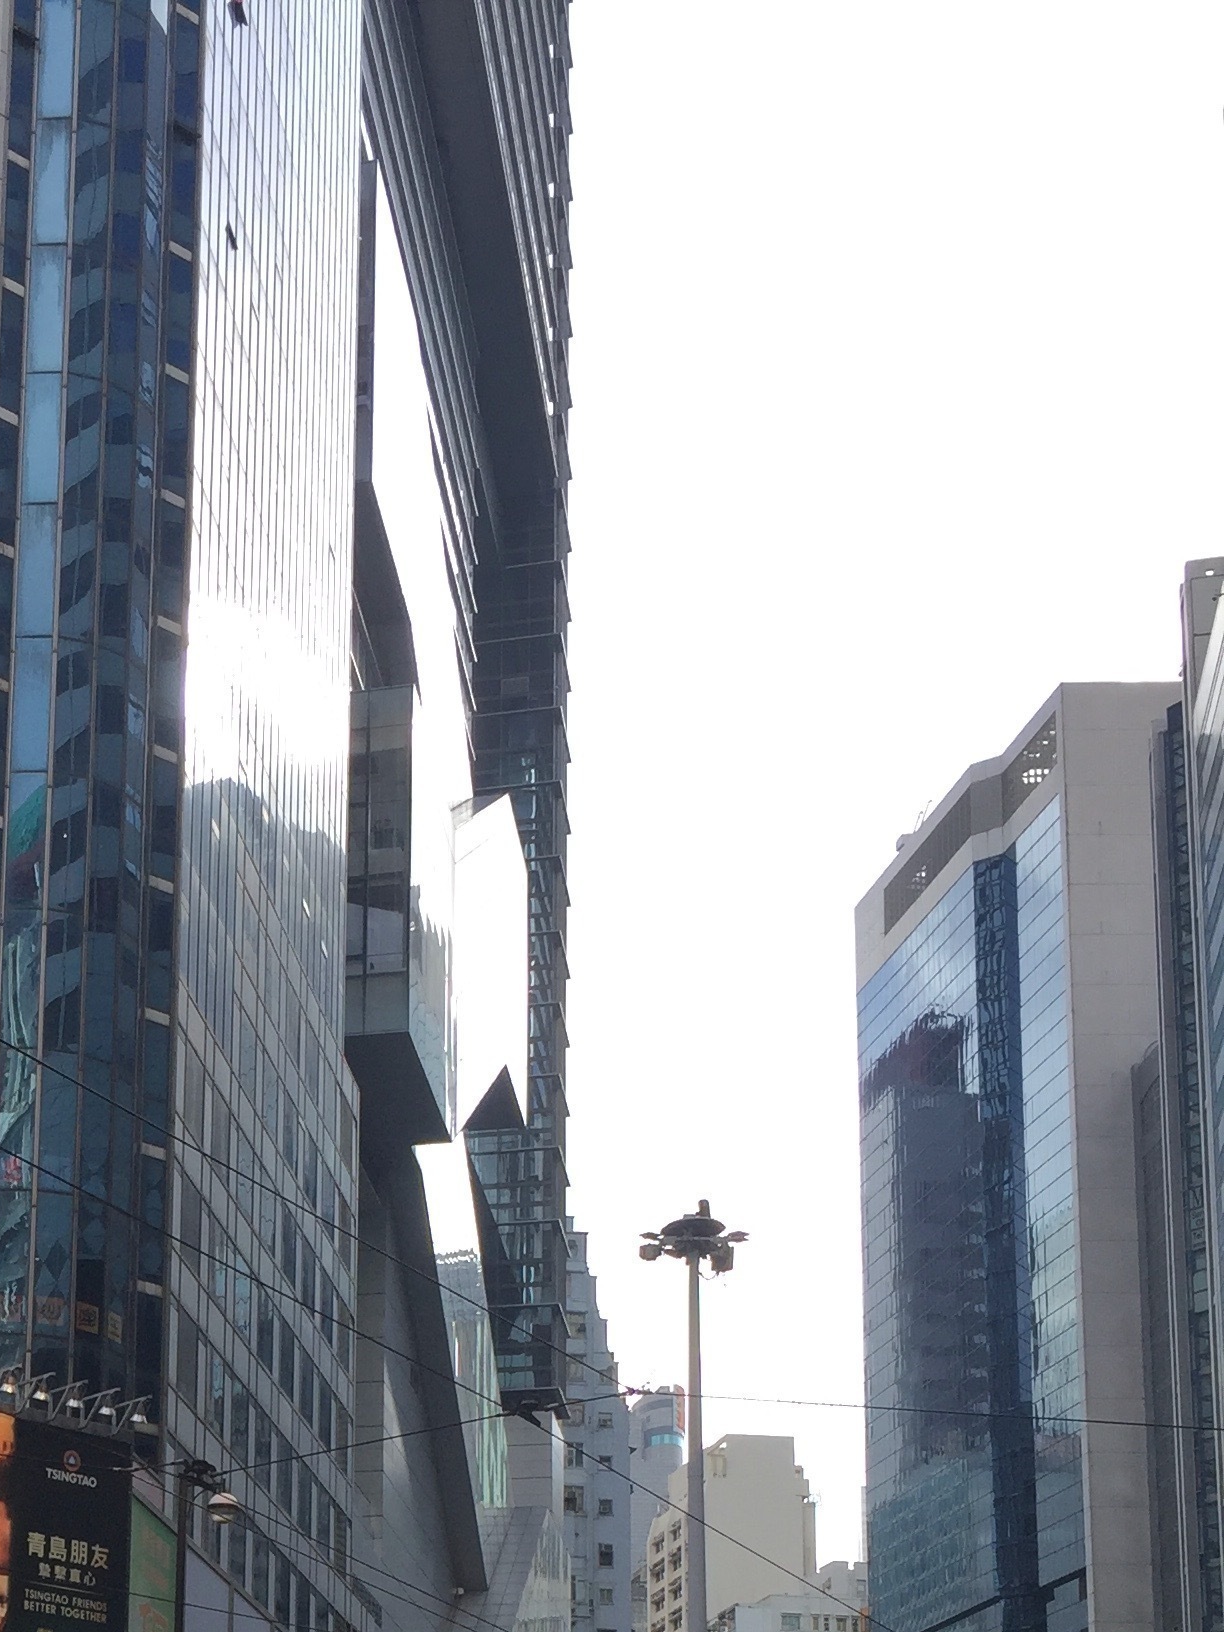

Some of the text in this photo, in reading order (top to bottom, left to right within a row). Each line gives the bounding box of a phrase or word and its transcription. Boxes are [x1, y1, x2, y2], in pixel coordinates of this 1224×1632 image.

[45, 1467, 98, 1489] TSINGTAO
[26, 1530, 110, 1570] 青島朋友
[23, 1599, 107, 1624] BETTER TOGETHER
[24, 1588, 108, 1613] TSINGTAO FRIENDS
